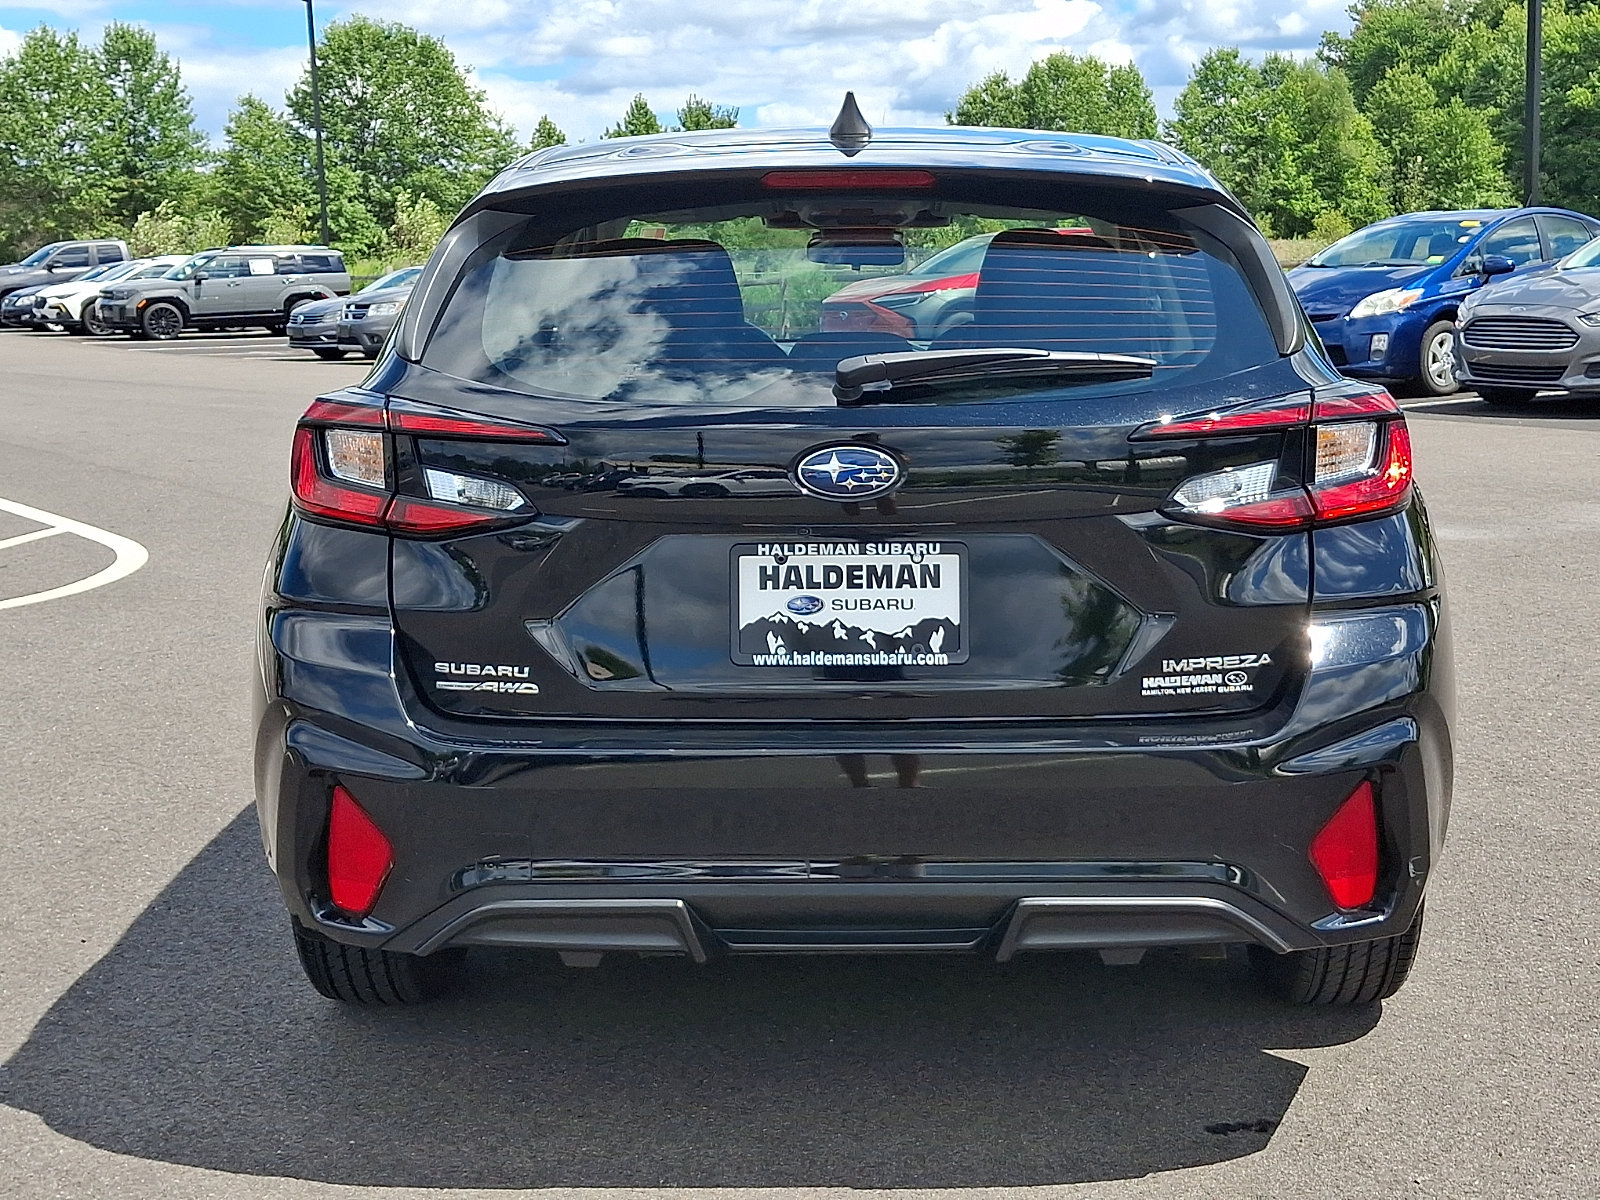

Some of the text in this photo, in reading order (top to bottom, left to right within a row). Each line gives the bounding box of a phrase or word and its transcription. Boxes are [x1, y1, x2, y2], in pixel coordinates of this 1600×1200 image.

[757, 543, 941, 556] HALDEMAN SUBARU
[758, 563, 941, 591] HALDEMAN
[831, 598, 915, 611] SUBARU
[752, 650, 949, 666] www.haldemansubaru.com
[1162, 653, 1272, 673] IMPREZA
[434, 662, 530, 678] SUBARU
[472, 681, 540, 695] AWD
[1142, 673, 1223, 689] HALDEMAN
[1217, 684, 1253, 693] SUBARU
